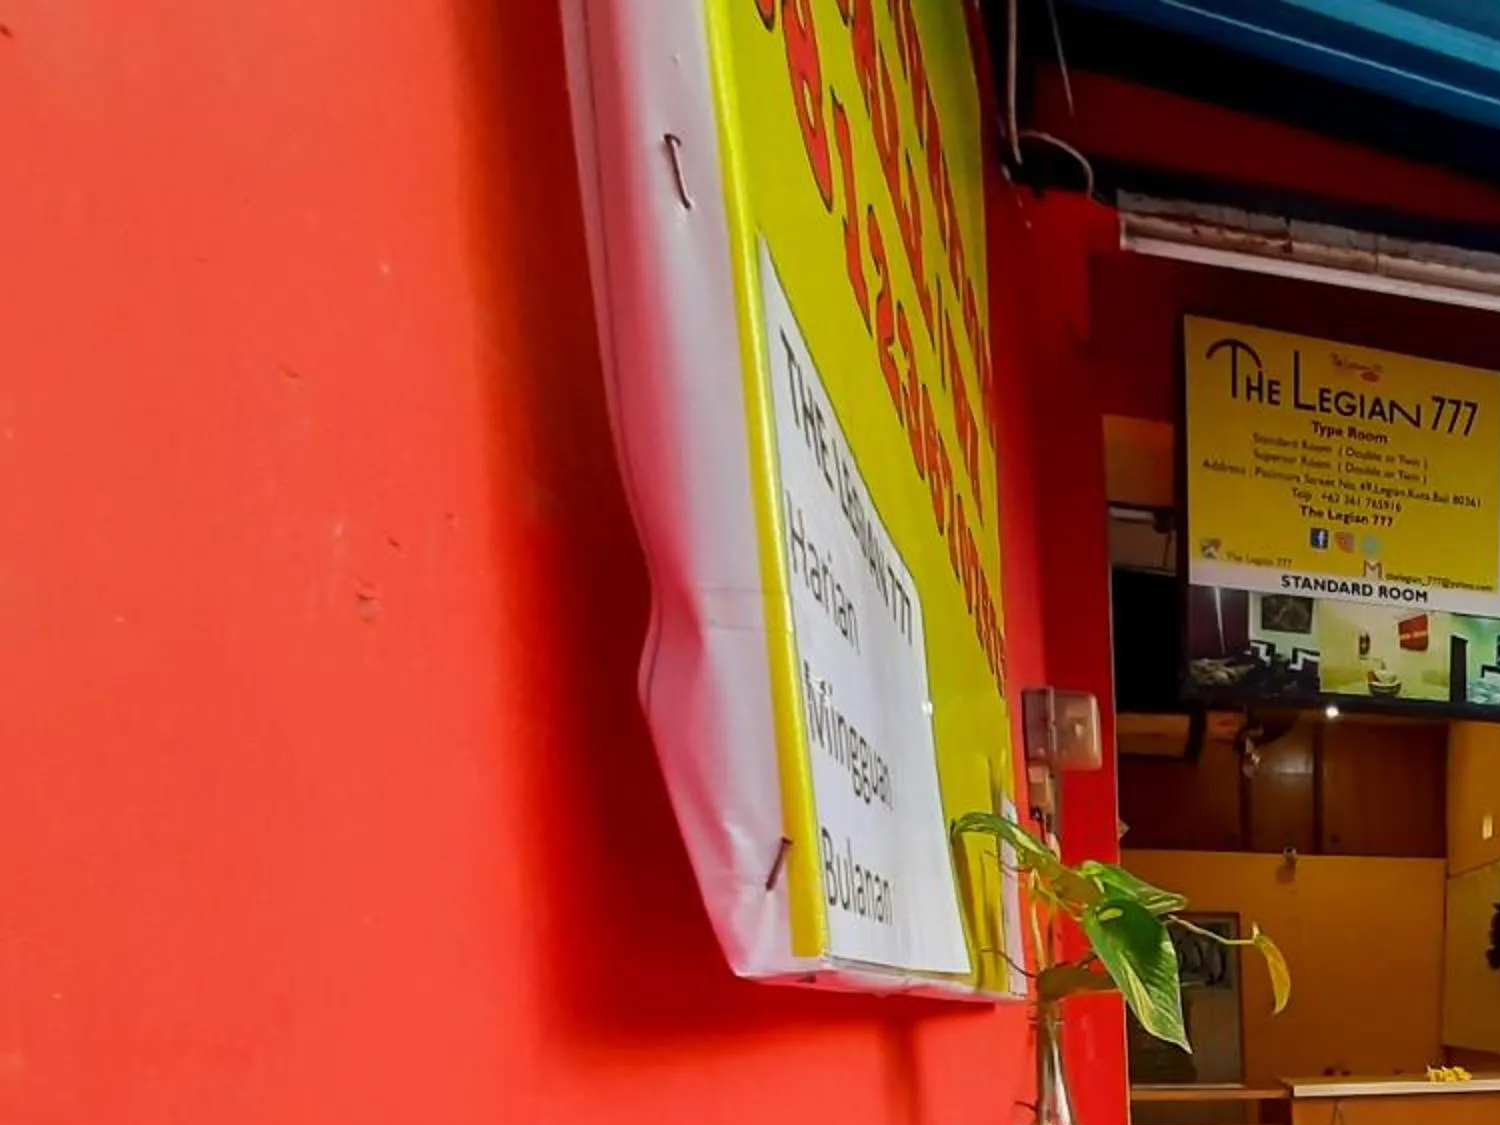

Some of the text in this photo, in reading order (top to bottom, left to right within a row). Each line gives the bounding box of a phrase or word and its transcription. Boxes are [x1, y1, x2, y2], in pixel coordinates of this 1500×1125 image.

[1205, 338, 1479, 438] THE LEGIAN 777
[1311, 420, 1389, 445] Type Room
[779, 325, 835, 493] THE
[886, 562, 913, 648] 777
[1299, 504, 1394, 528] The Legian 777
[786, 488, 862, 658] Harian
[1280, 574, 1429, 603] STANDARD ROOM
[803, 659, 894, 812] Mingguan
[821, 827, 893, 928] Bulanan
